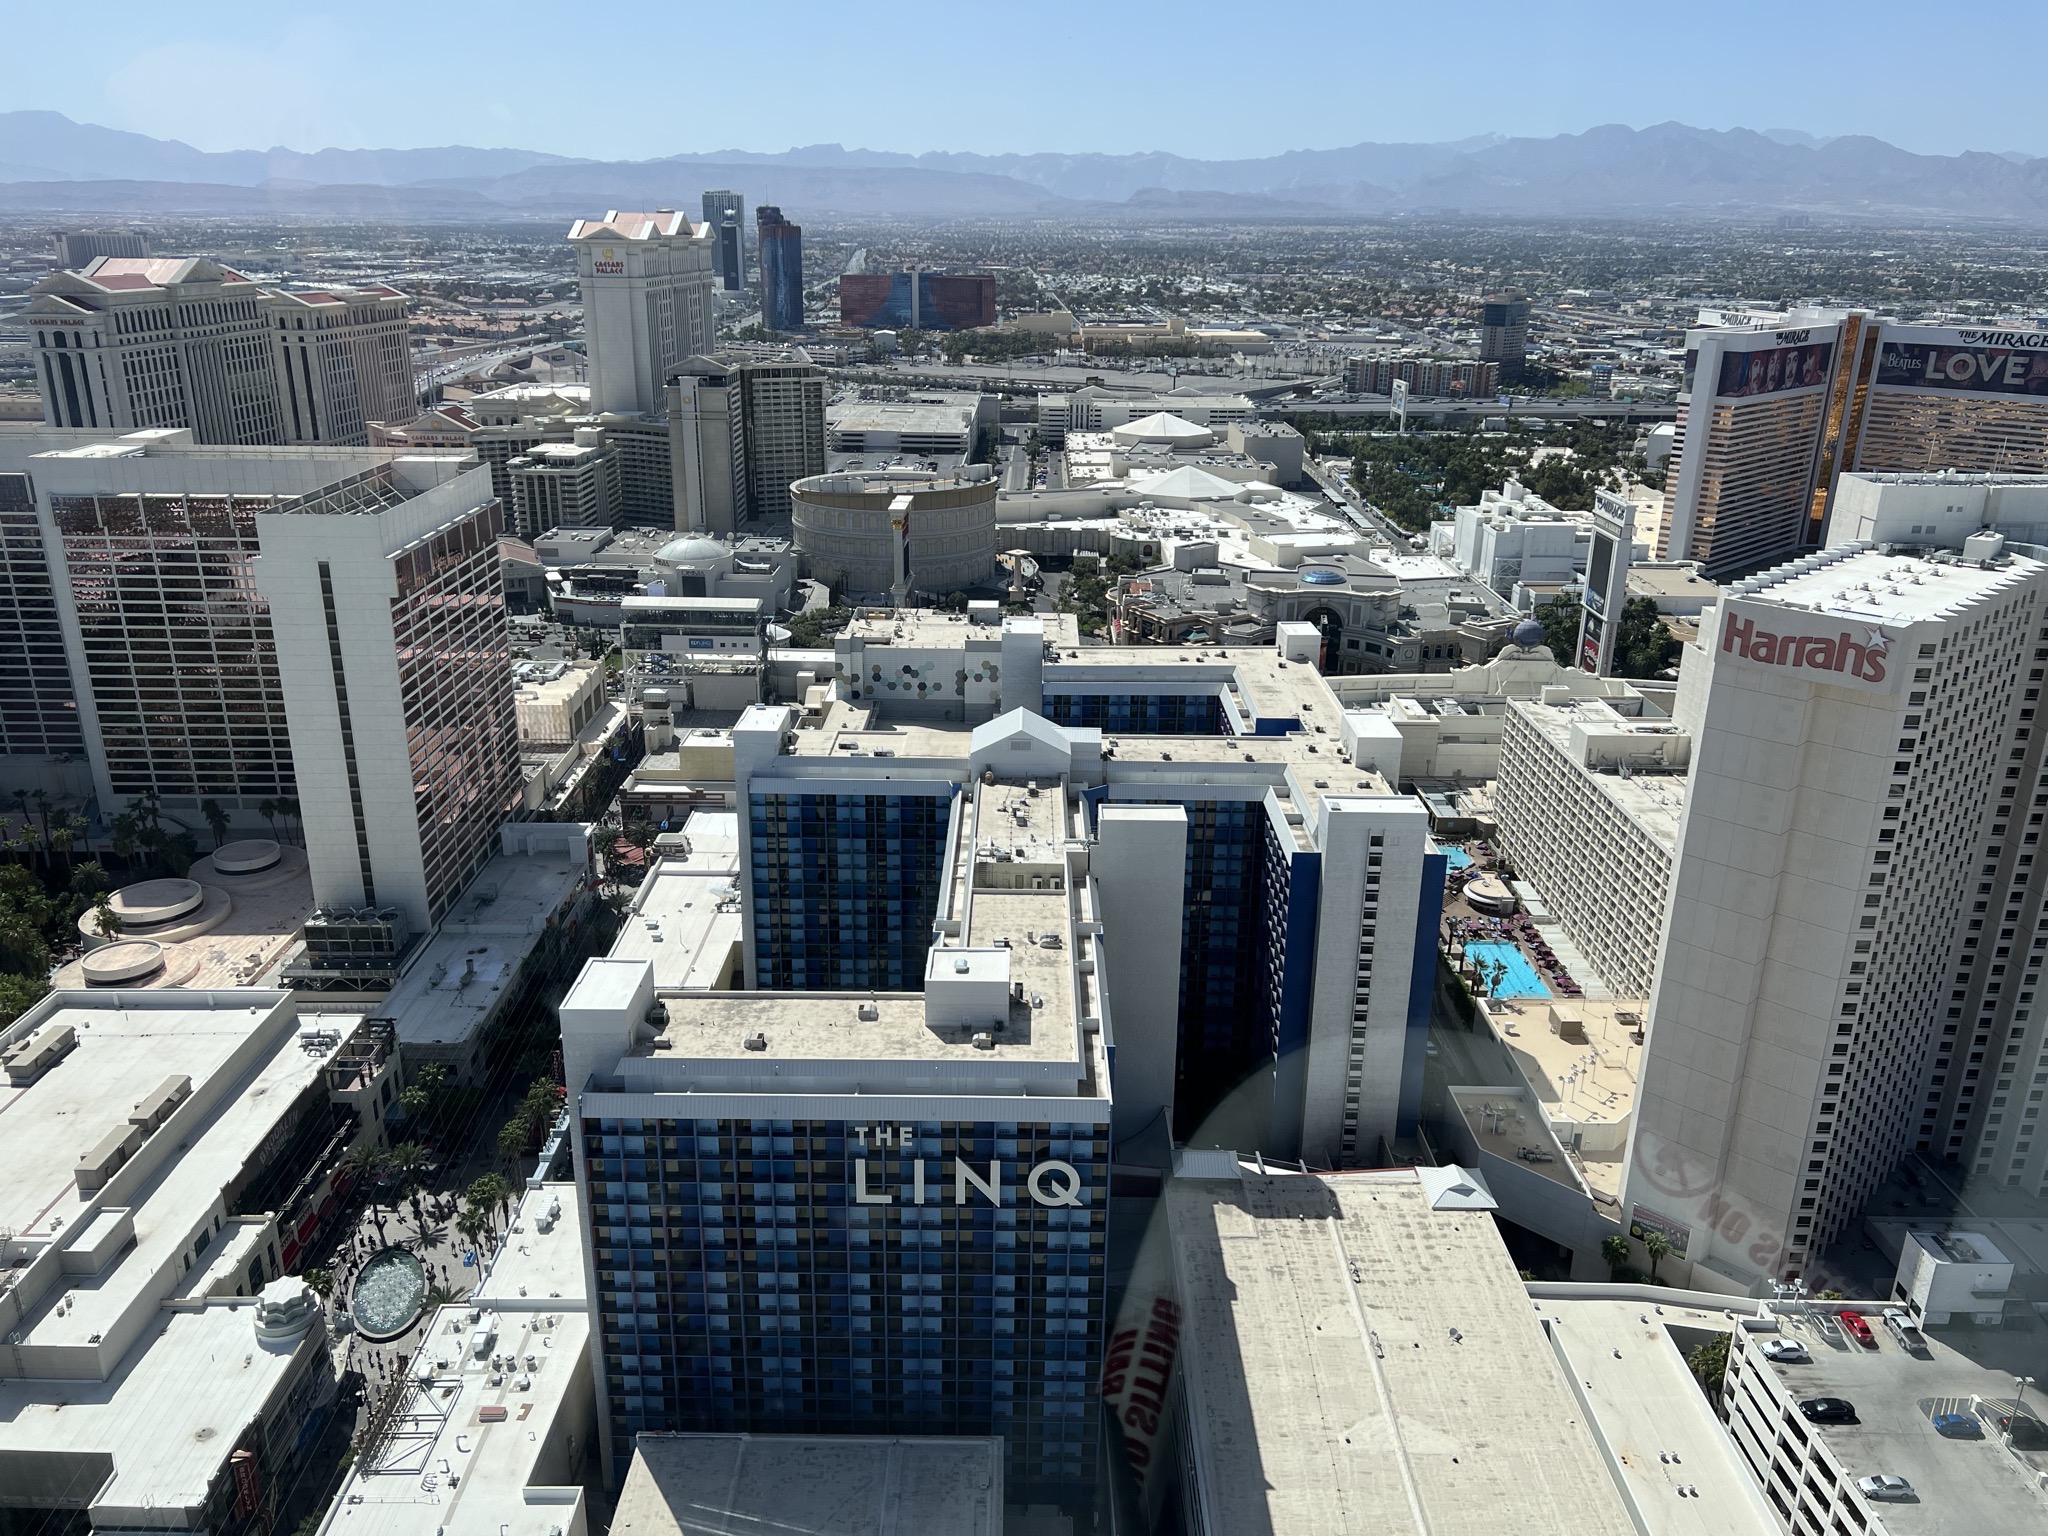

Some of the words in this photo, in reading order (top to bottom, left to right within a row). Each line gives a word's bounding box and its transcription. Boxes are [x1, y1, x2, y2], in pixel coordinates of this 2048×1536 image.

[1777, 329, 1810, 345] MIRAGE
[1958, 330, 1978, 339] THE
[1925, 351, 2030, 385] LOVE
[259, 1110, 298, 1164] BROOKLYN
[854, 1126, 913, 1147] THE
[855, 1156, 1083, 1208] LINQ
[239, 1465, 252, 1511] BROOKLYN
